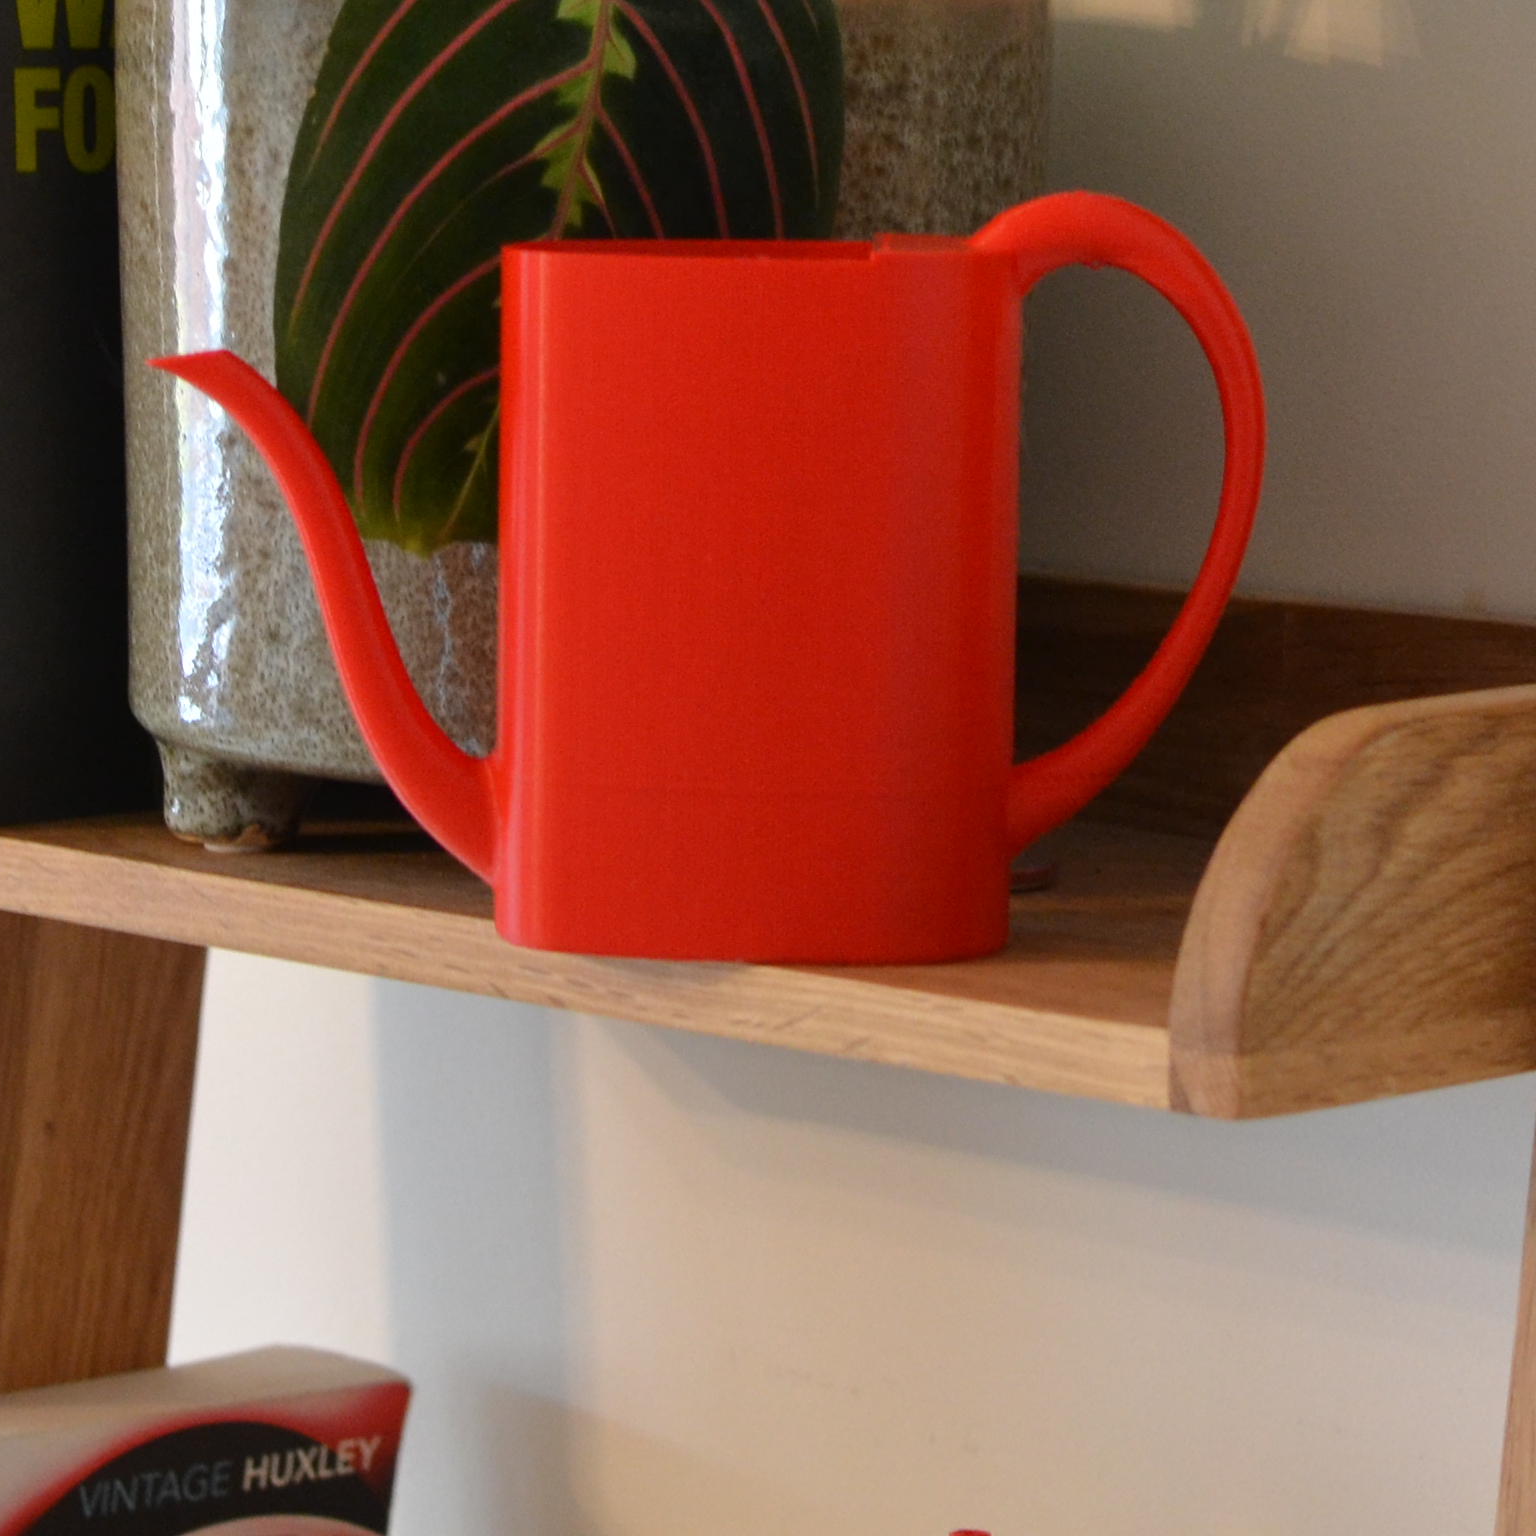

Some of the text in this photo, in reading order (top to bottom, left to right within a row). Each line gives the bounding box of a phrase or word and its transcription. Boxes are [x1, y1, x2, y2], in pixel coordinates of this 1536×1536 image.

[13, 64, 117, 175] FO
[78, 1434, 383, 1519] VINTAGE HUXLEY
